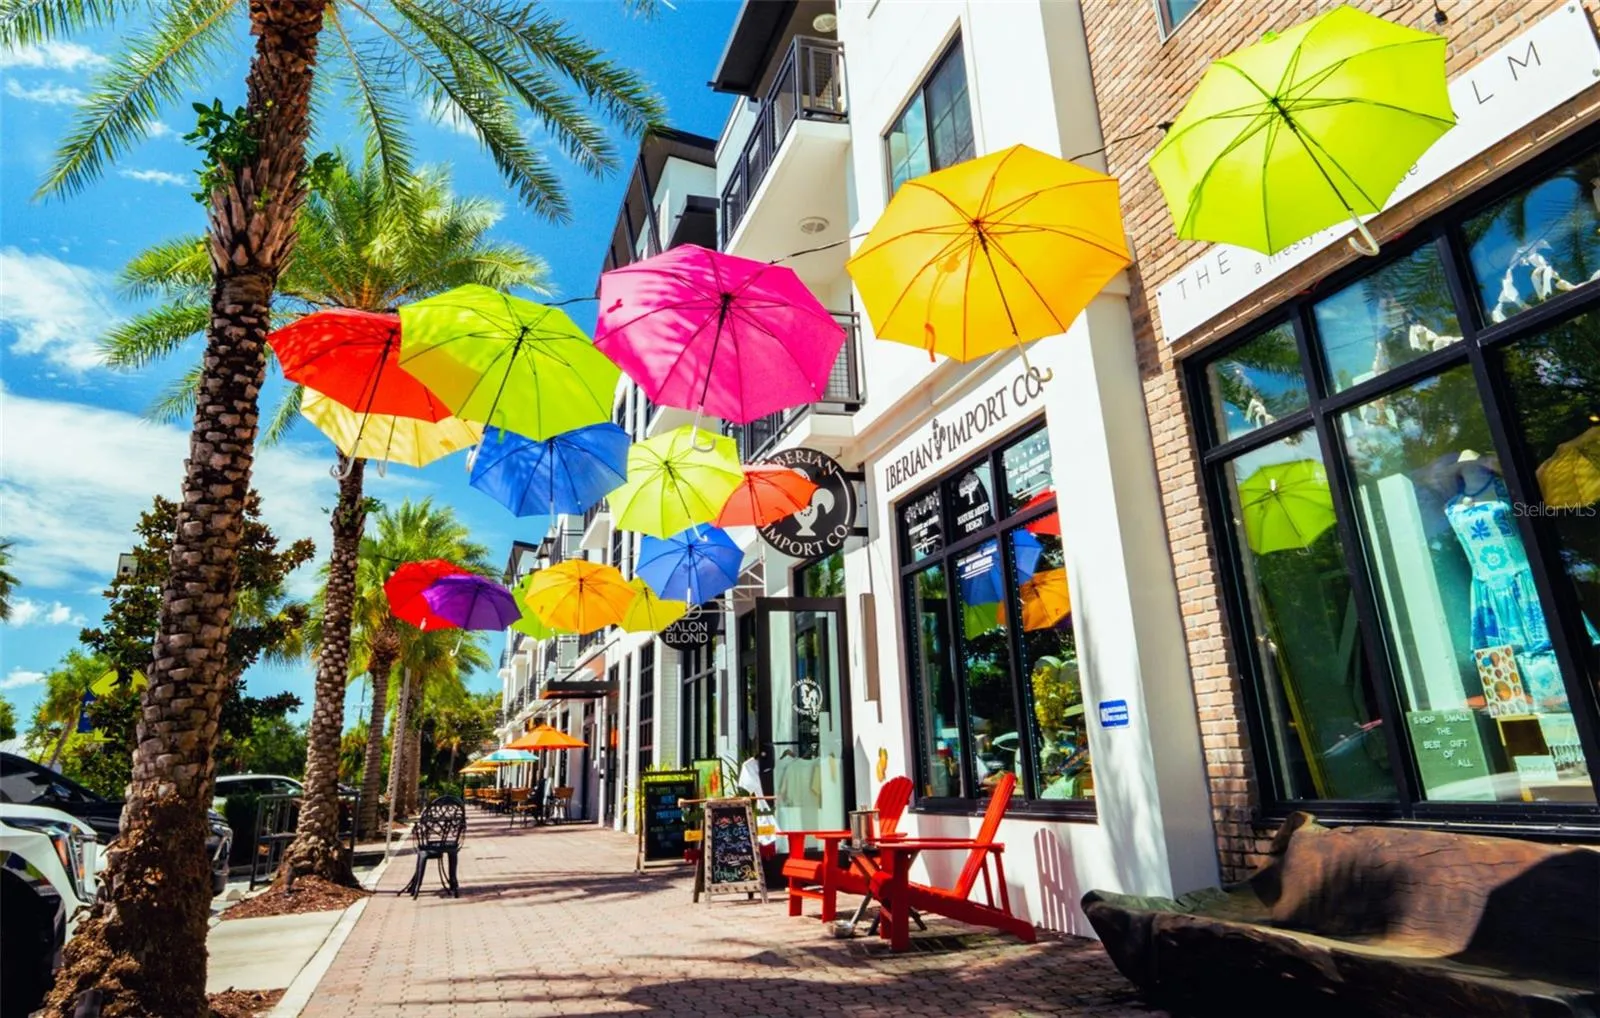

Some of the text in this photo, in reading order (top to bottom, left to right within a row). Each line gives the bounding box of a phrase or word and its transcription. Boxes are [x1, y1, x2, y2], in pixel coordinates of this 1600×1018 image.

[1176, 250, 1231, 300] THE
[885, 437, 933, 493] IBERIAN
[945, 386, 1008, 453] IMPORT
[772, 450, 838, 475] BERIAN
[761, 522, 824, 557] IMPORT
[665, 621, 708, 632] SALON
[665, 632, 709, 644] BLOND
[1413, 715, 1436, 725] SHOP
[1436, 727, 1453, 736] THE
[1443, 749, 1456, 759] OF
[1457, 759, 1475, 768] ALL
